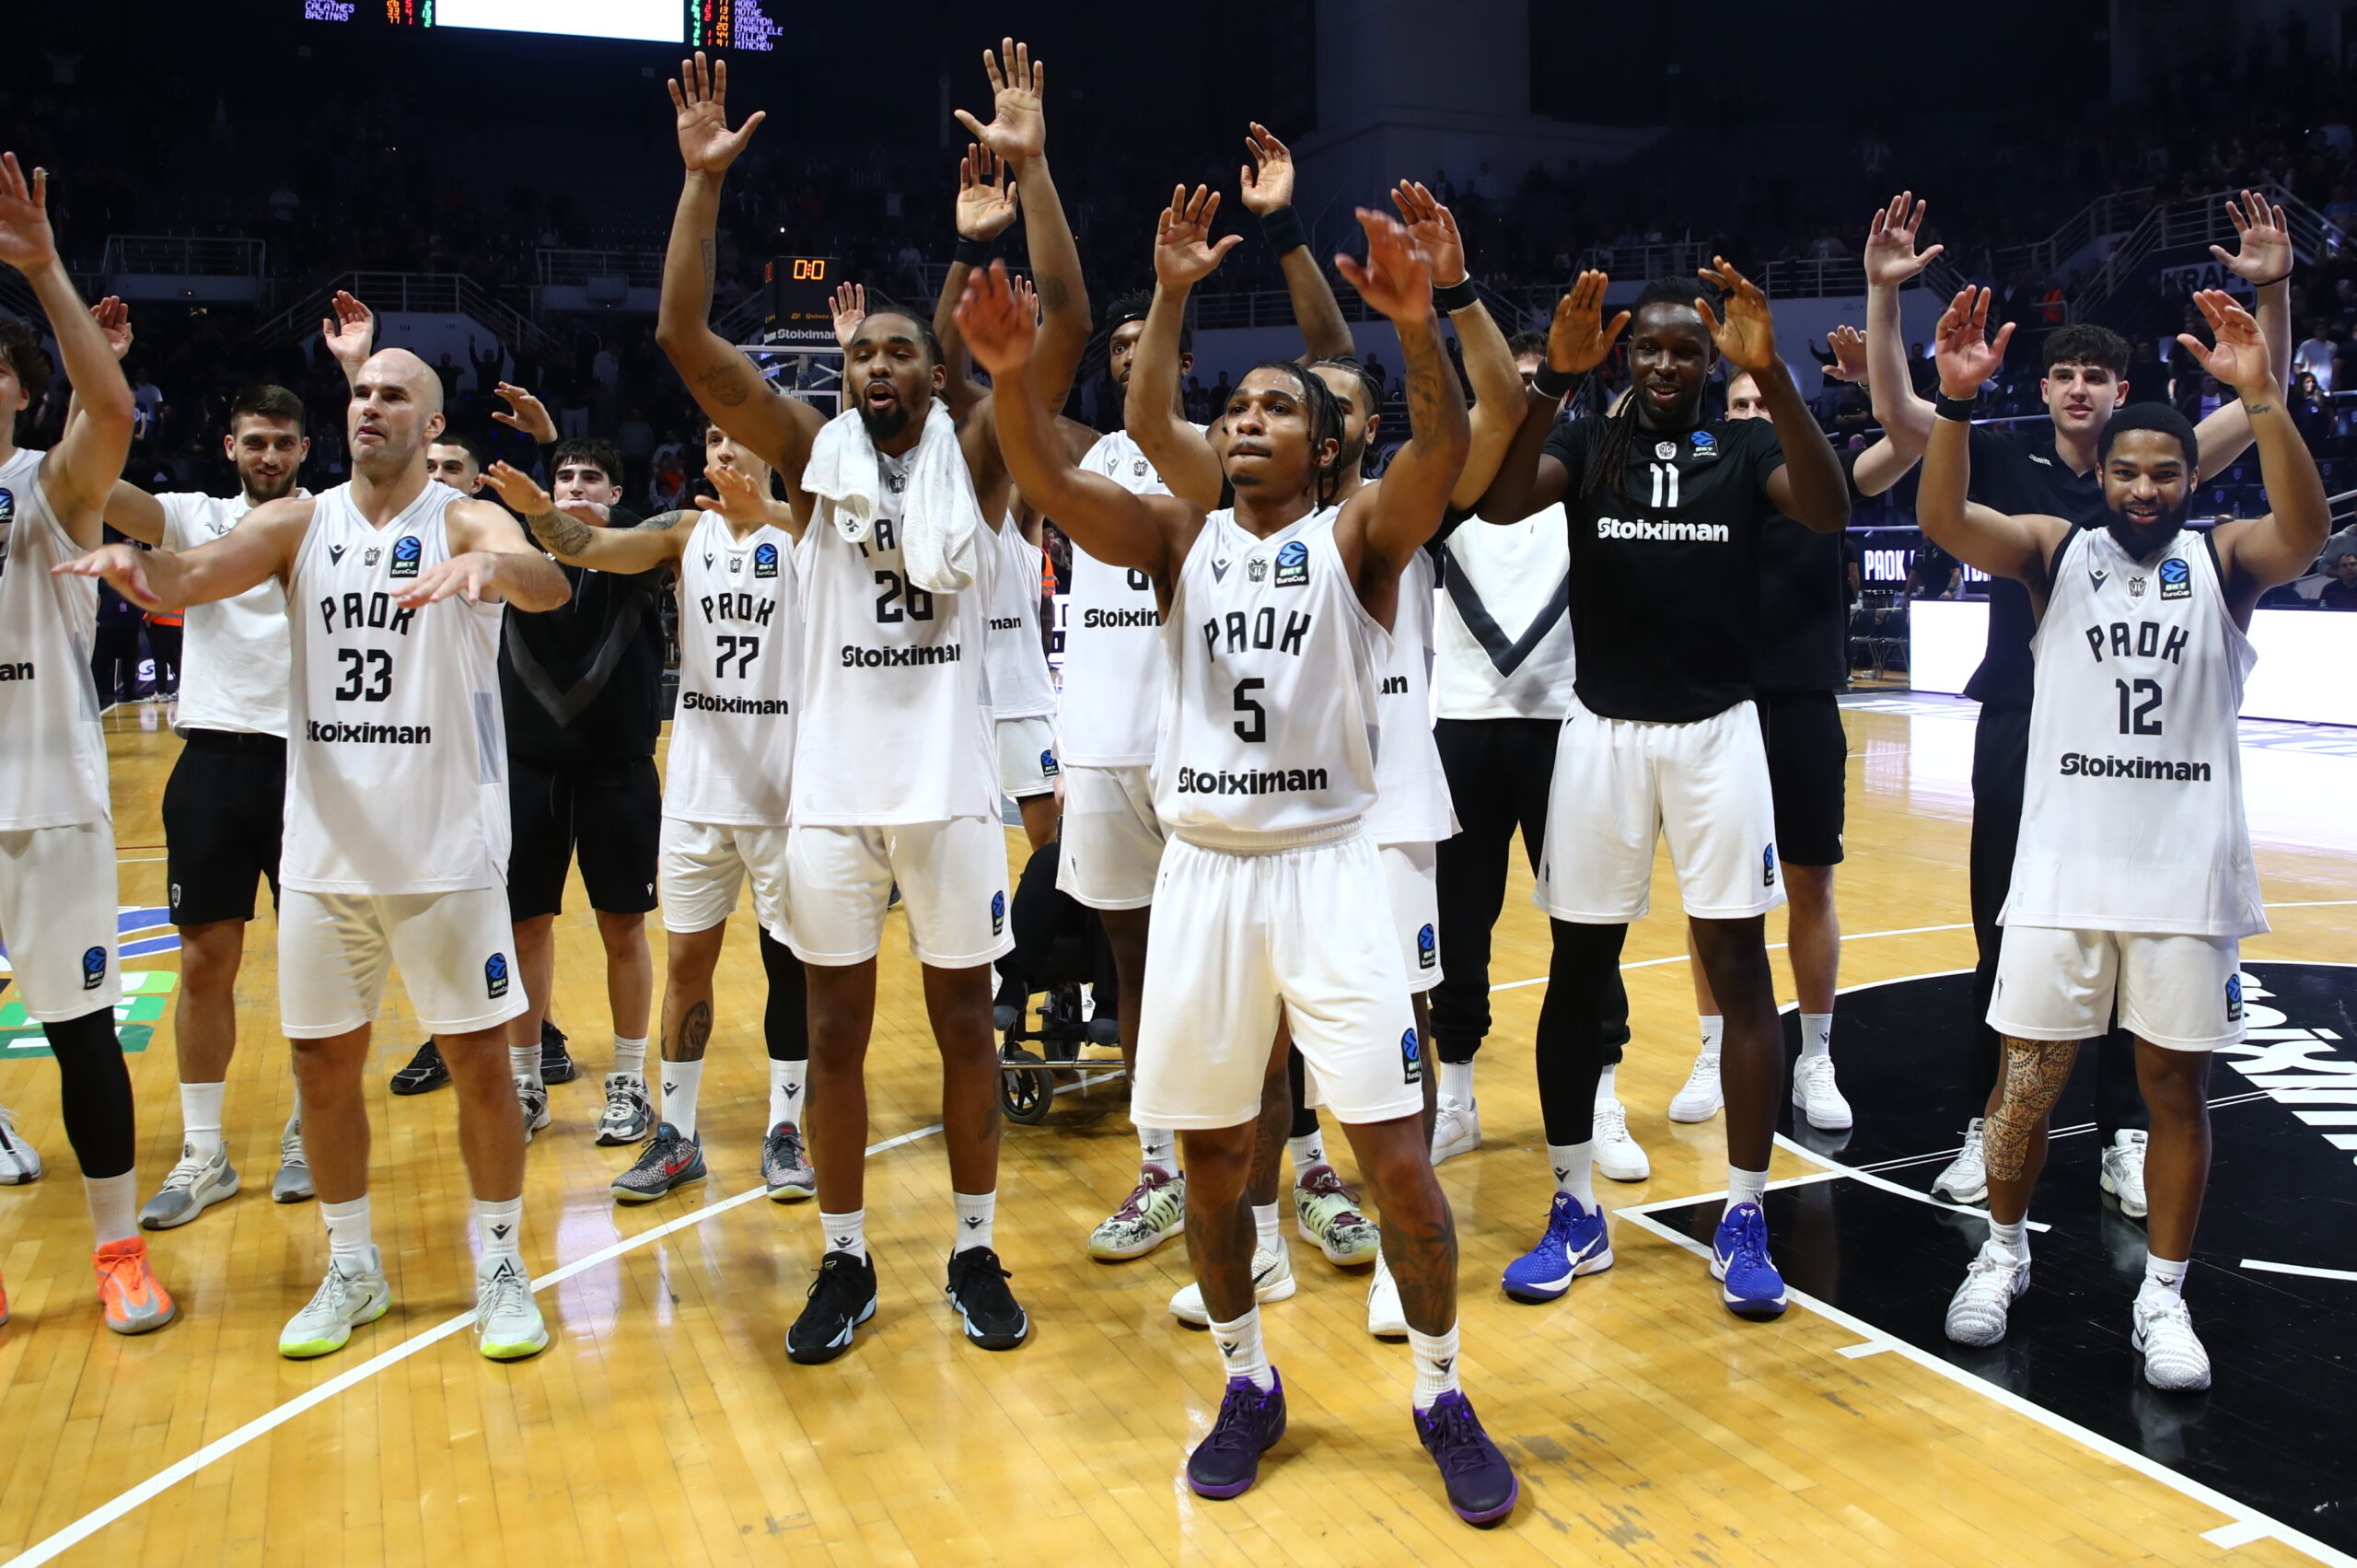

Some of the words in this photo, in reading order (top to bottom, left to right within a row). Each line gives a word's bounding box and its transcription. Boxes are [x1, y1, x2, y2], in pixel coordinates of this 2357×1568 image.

[305, 1, 354, 13] CALATHES
[305, 9, 349, 21] BAZINAS
[720, 6, 728, 14] 13
[716, 21, 728, 31] 20
[735, 41, 773, 52] MINCHEV
[1649, 462, 1679, 507] 11
[1597, 517, 1729, 542] Stoiximan
[1864, 550, 1907, 581] PAOK
[701, 592, 775, 627] PAOK
[1203, 607, 1312, 663] PAOK
[2085, 621, 2189, 665] PAOK
[715, 635, 760, 679] 77
[335, 647, 393, 702] 33
[682, 691, 789, 714] Stoiximan
[1233, 678, 1266, 742] 5
[2115, 678, 2163, 736] 12
[1178, 766, 1328, 795] Stoiximan
[2060, 752, 2211, 782] Stoiximan
